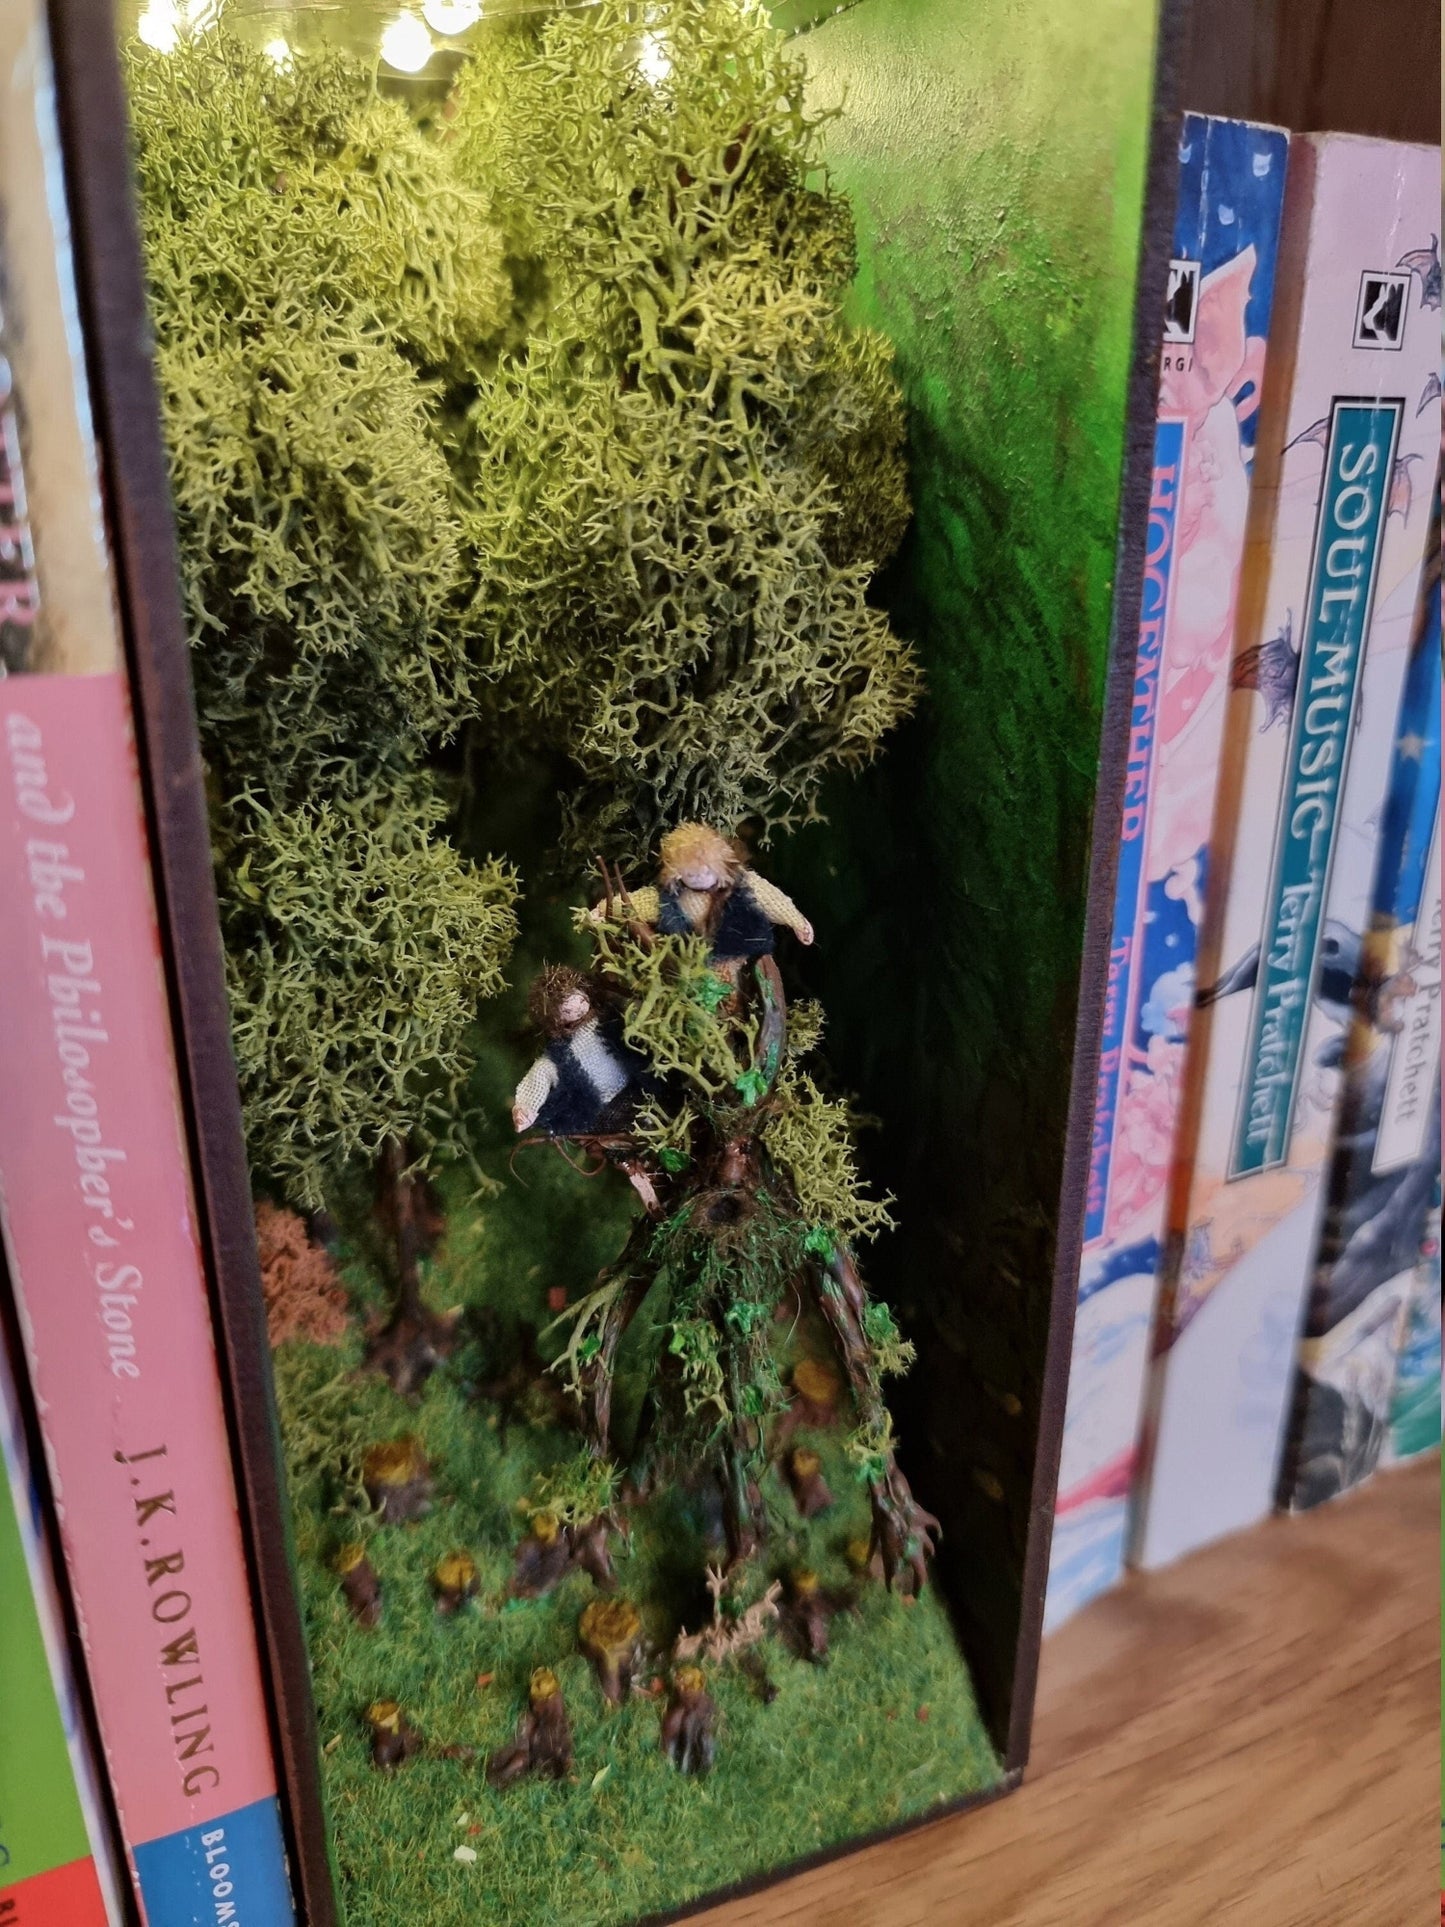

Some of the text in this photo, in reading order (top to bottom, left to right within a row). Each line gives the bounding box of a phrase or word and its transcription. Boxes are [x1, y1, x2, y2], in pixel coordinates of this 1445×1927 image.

[7, 711, 143, 1381] and the Philosopher's Stone
[1247, 444, 1377, 1146] SOUL MUSIC Terry Pratchett
[1395, 981, 1441, 1124] Pratchett
